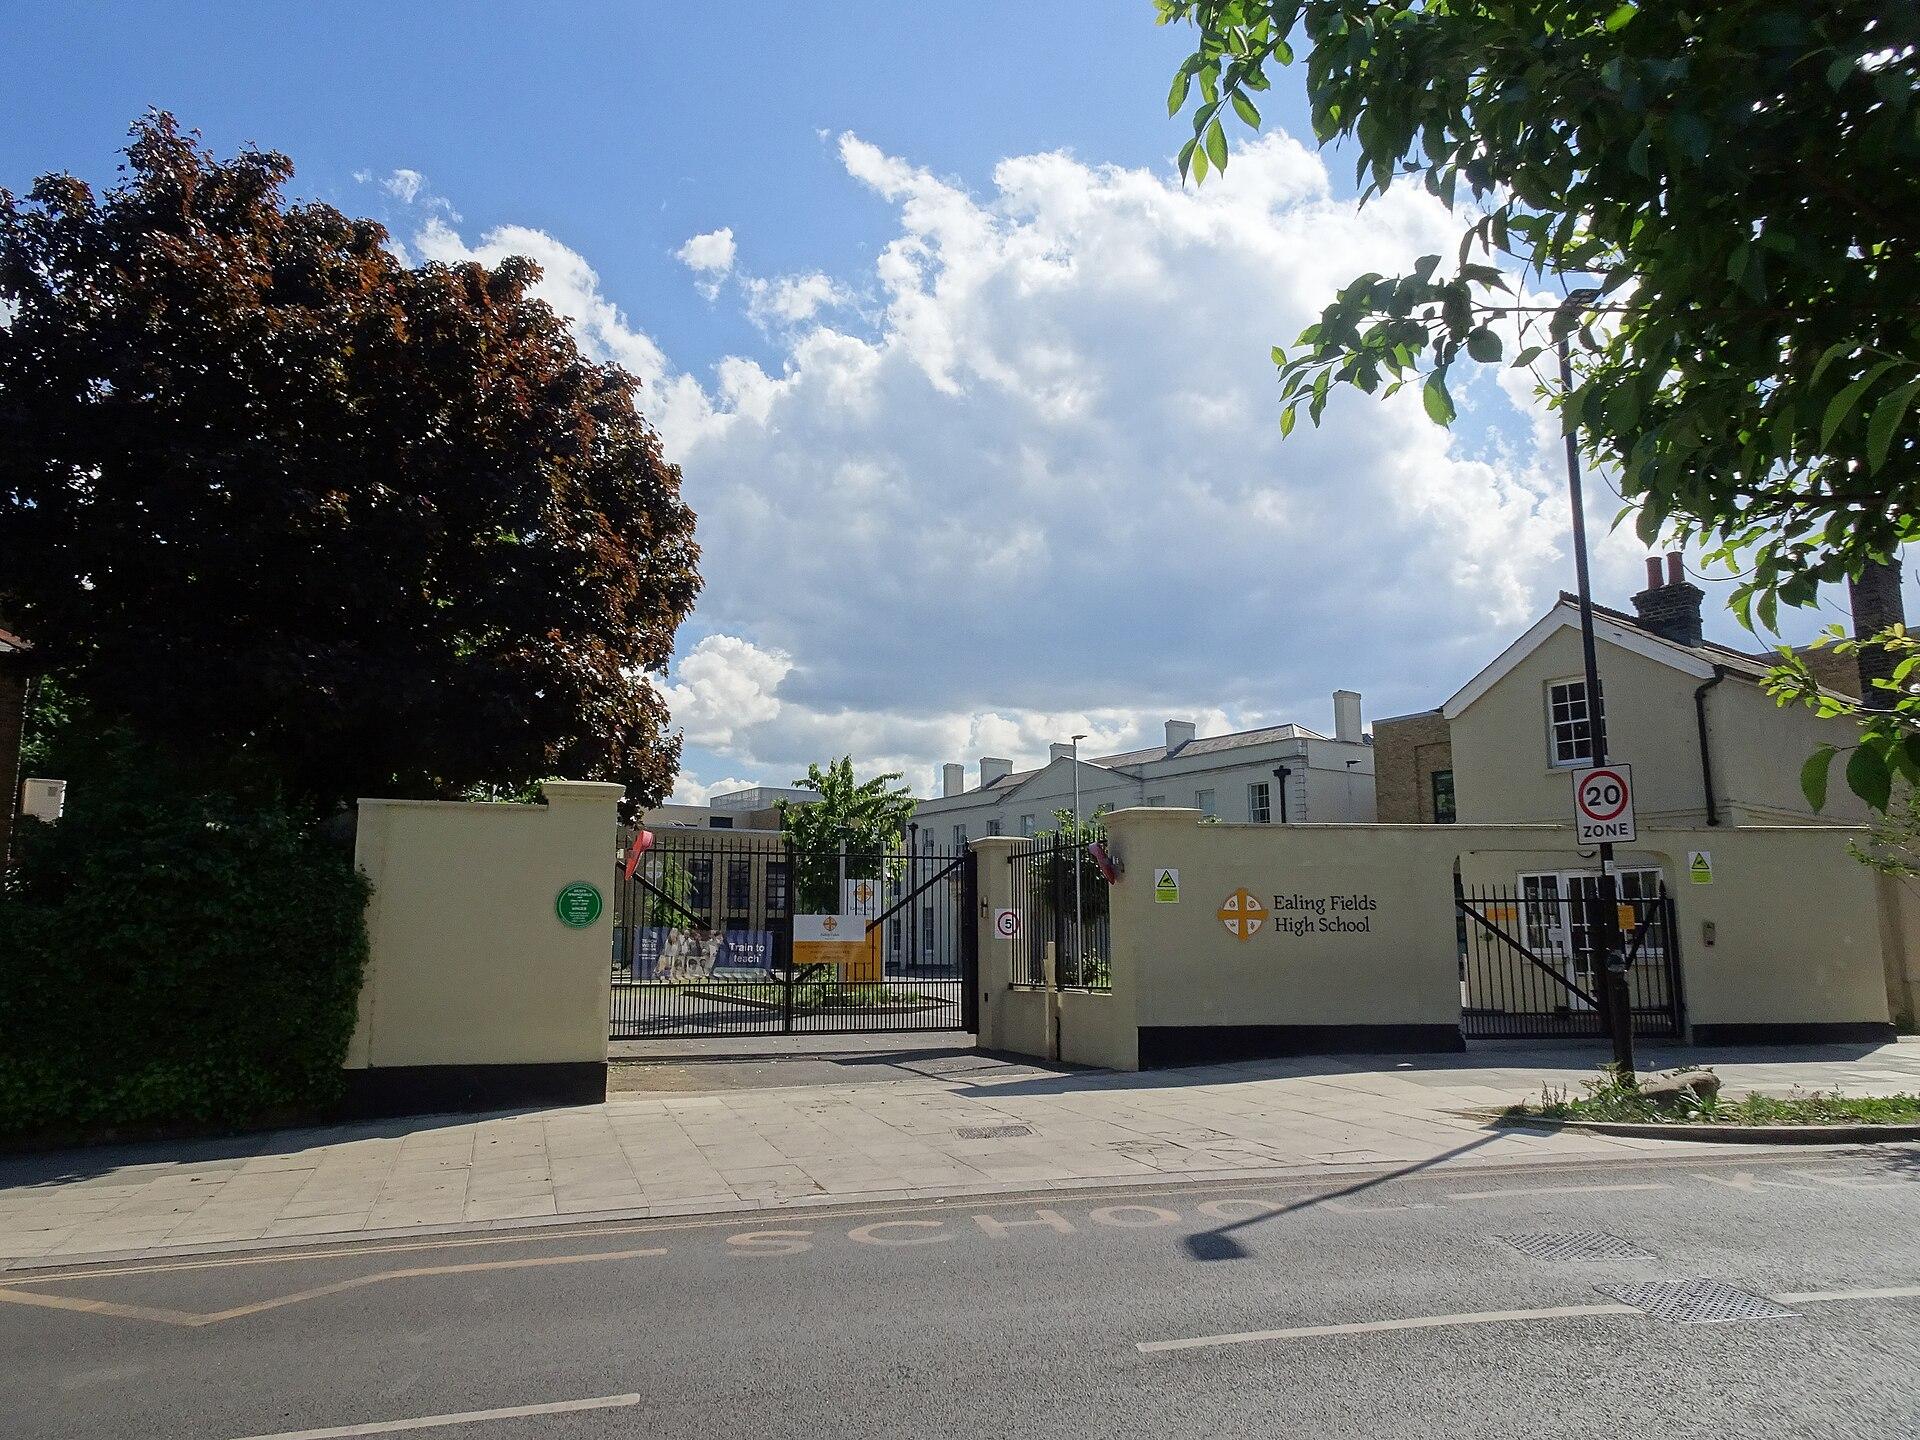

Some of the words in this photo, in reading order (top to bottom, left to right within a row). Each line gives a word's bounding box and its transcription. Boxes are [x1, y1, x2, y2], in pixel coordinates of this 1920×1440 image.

[1586, 784, 1621, 807] 20
[1583, 822, 1629, 838] ZONE
[1273, 894, 1326, 915] Ealing
[1330, 894, 1377, 911] Fields
[1004, 918, 1013, 929] 5
[1274, 916, 1315, 937] High
[1319, 916, 1371, 933] School
[728, 942, 753, 952] Train
[755, 943, 765, 952] to
